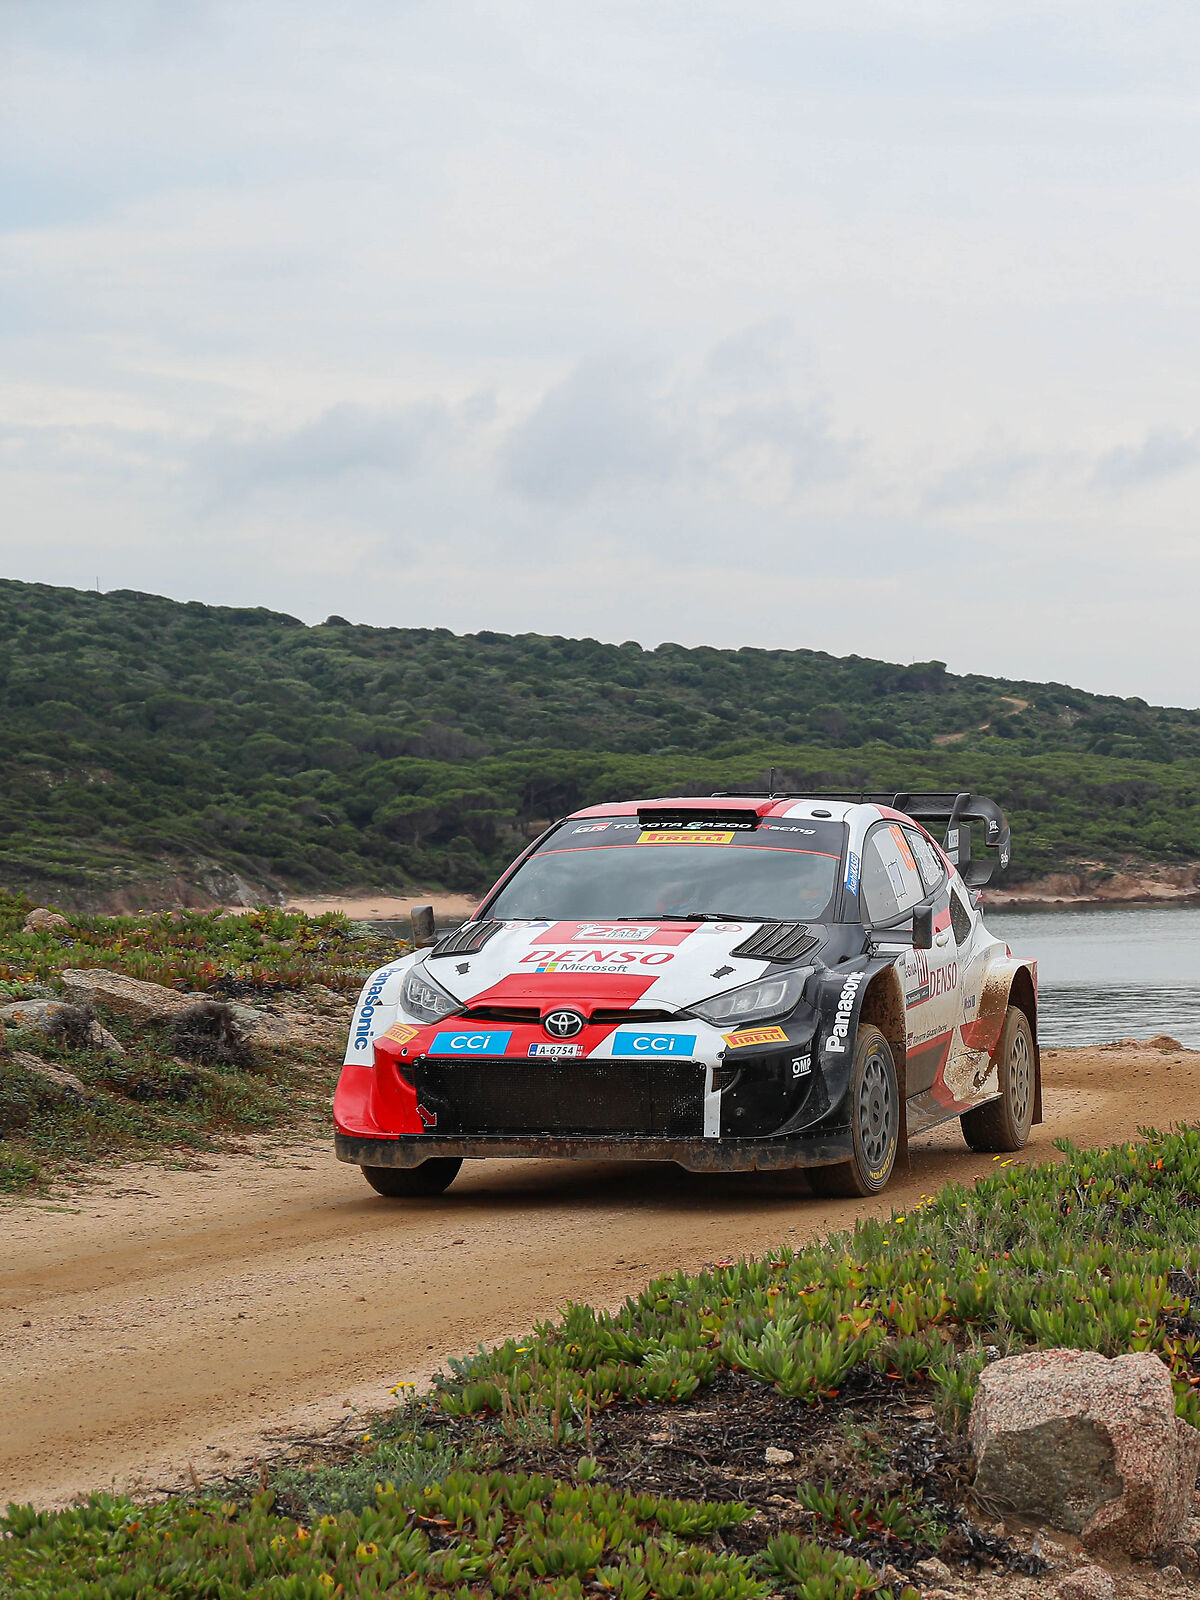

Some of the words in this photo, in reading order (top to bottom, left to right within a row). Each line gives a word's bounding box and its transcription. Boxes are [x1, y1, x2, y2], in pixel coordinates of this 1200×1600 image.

[614, 822, 682, 830] TOYOTA
[686, 821, 752, 830] GAZOO
[755, 823, 817, 836] Racing
[648, 832, 726, 842] PIRELLI
[519, 950, 675, 966] DENSO
[560, 963, 628, 973] Microsoft
[930, 962, 958, 998] DENSO
[355, 967, 405, 1050] Panasonic
[825, 971, 865, 1053] Panasonic
[728, 1028, 783, 1046] PIRELLI
[539, 1046, 574, 1055] A-6754
[792, 1057, 812, 1075] OMP
